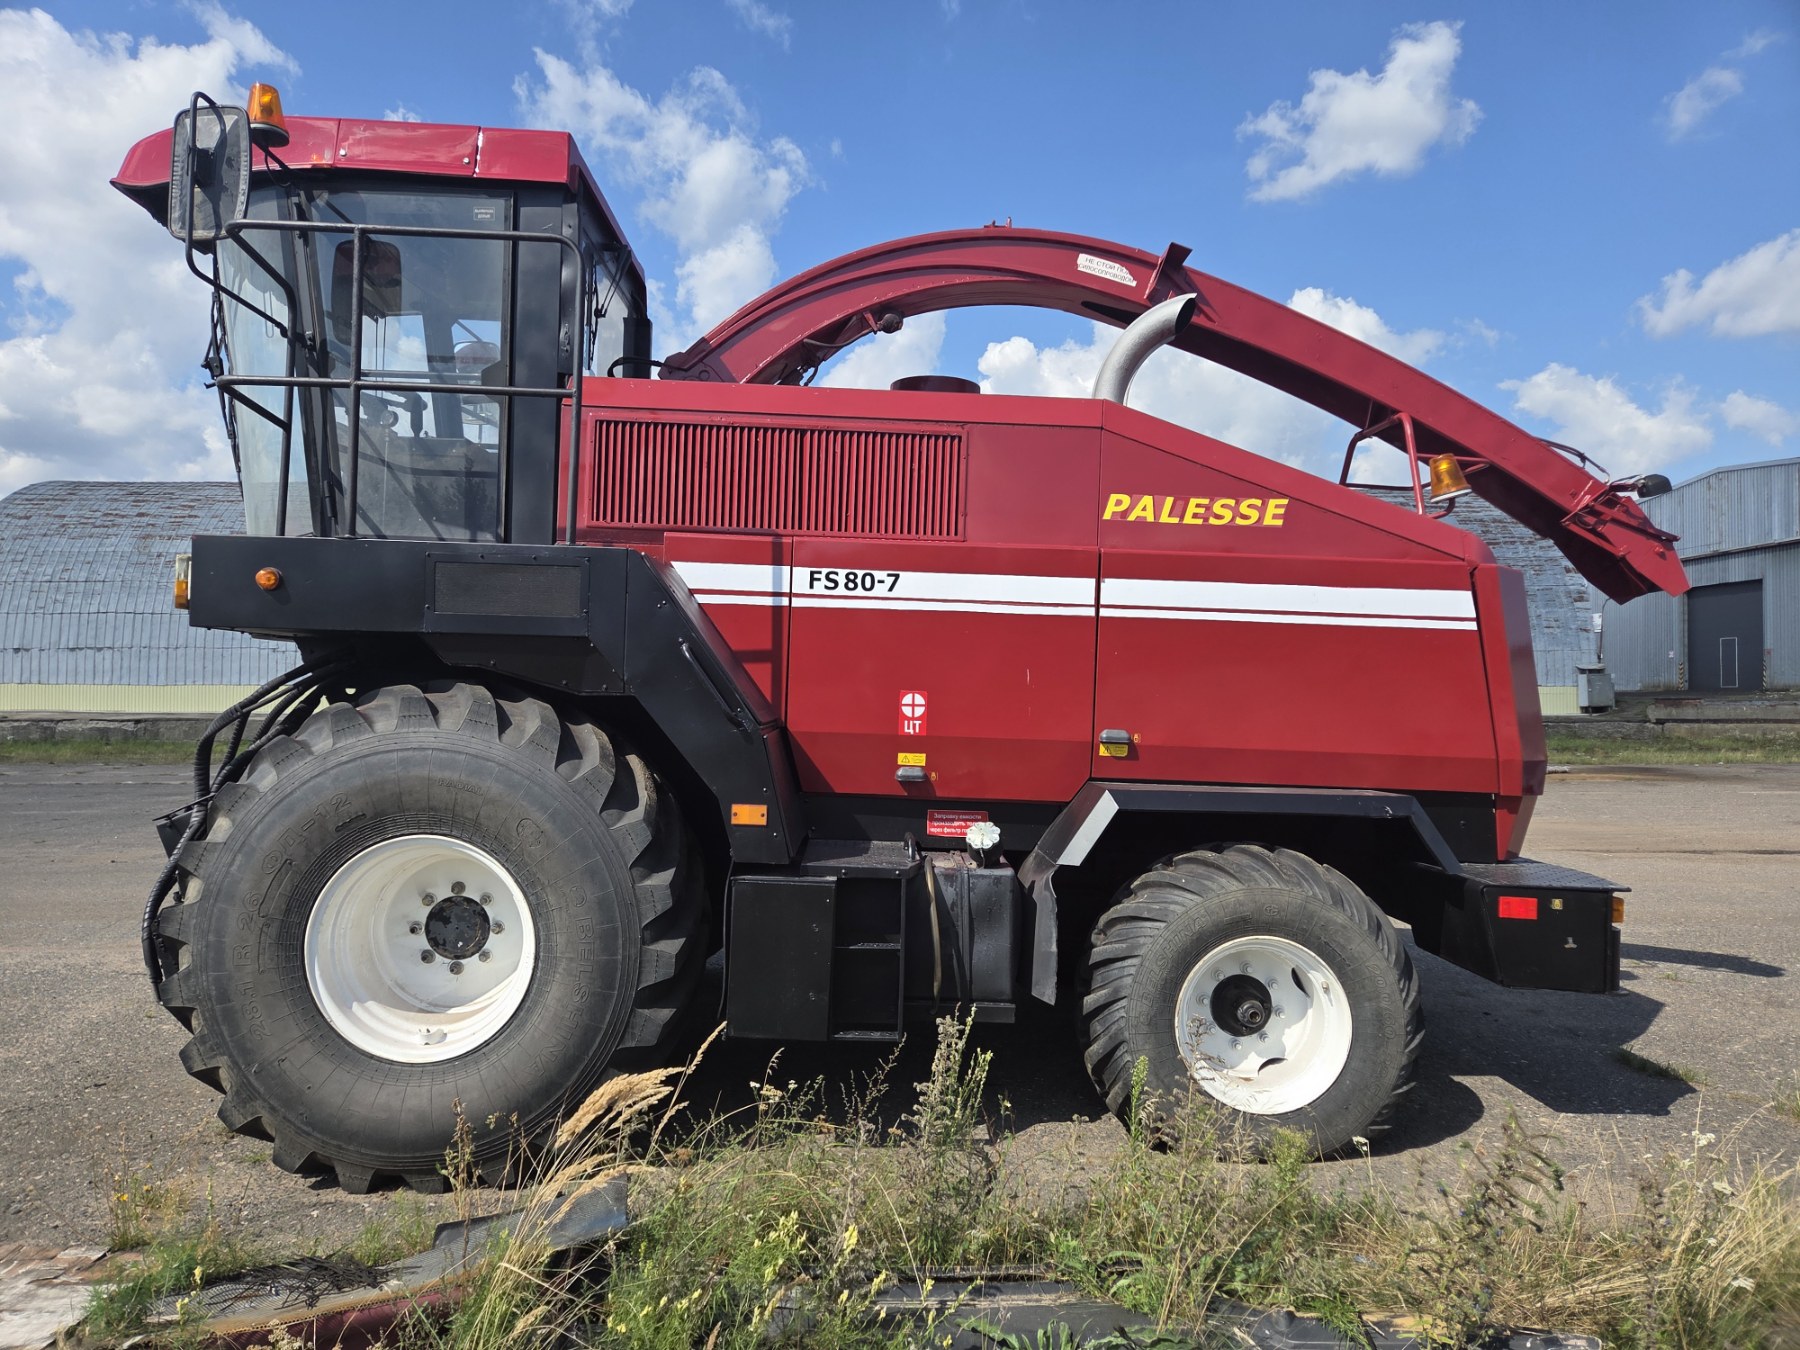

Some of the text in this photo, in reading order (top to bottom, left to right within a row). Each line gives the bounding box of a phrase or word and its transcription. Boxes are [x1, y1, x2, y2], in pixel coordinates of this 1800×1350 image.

[1102, 493, 1290, 526] PALESSE
[904, 720, 922, 735] ЦТ
[438, 775, 486, 797] RADIAL
[237, 891, 264, 933] 26
[232, 943, 251, 967] R
[1142, 915, 1207, 1006] BELSHINA
[525, 916, 596, 1084] BELSHINA
